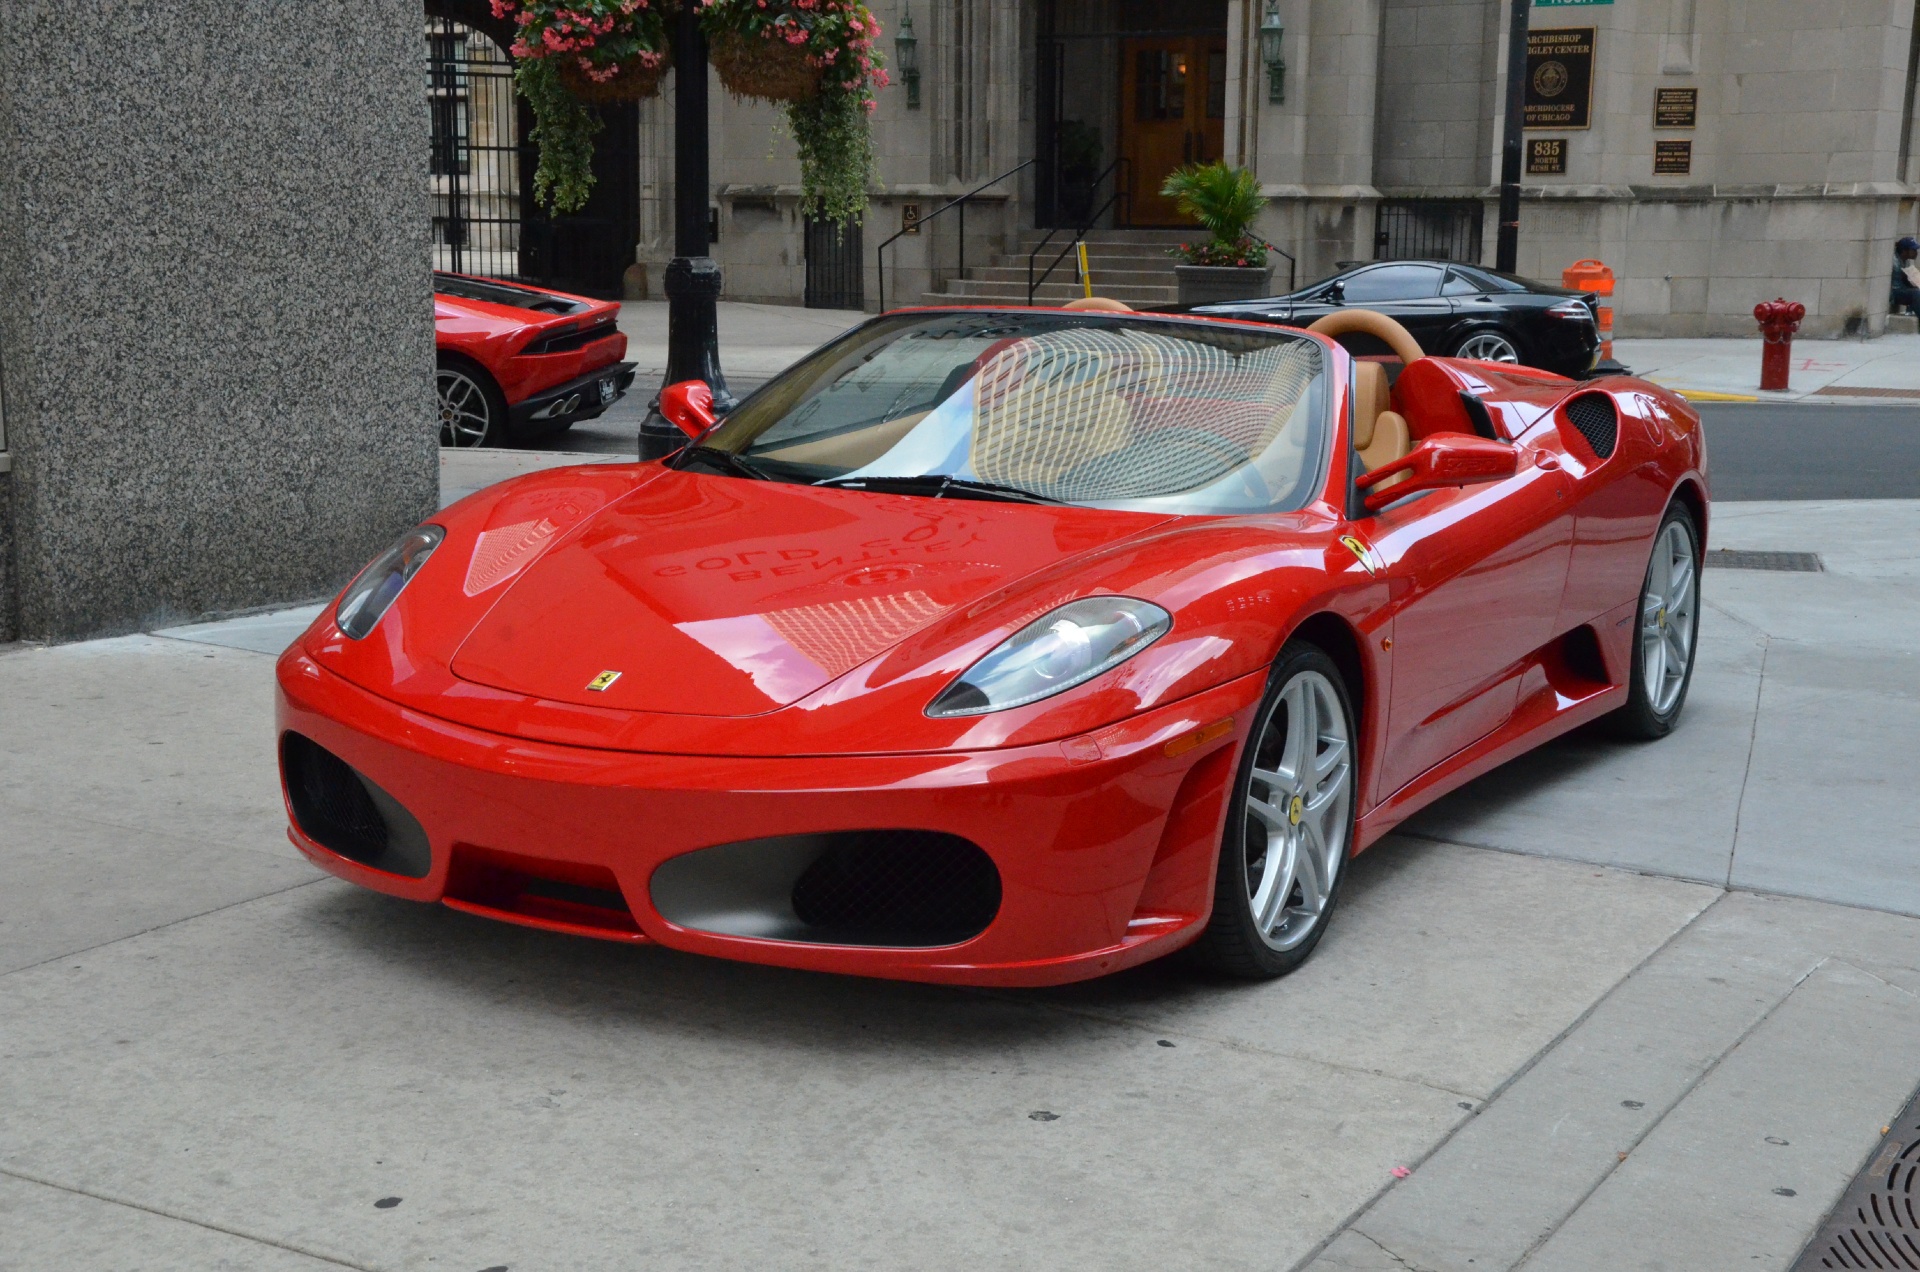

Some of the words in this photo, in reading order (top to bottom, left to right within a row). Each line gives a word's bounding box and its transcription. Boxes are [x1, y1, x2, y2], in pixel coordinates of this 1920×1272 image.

[1527, 34, 1581, 44] ARCHBISHOP
[1527, 46, 1553, 55] IGLEY
[1554, 45, 1589, 54] CENTER
[1523, 104, 1575, 112] ARCHDIOCESE
[1526, 114, 1536, 122] OF
[1537, 113, 1570, 121] CHICAGO
[1534, 141, 1560, 156] 835
[1530, 164, 1549, 172] RUSH
